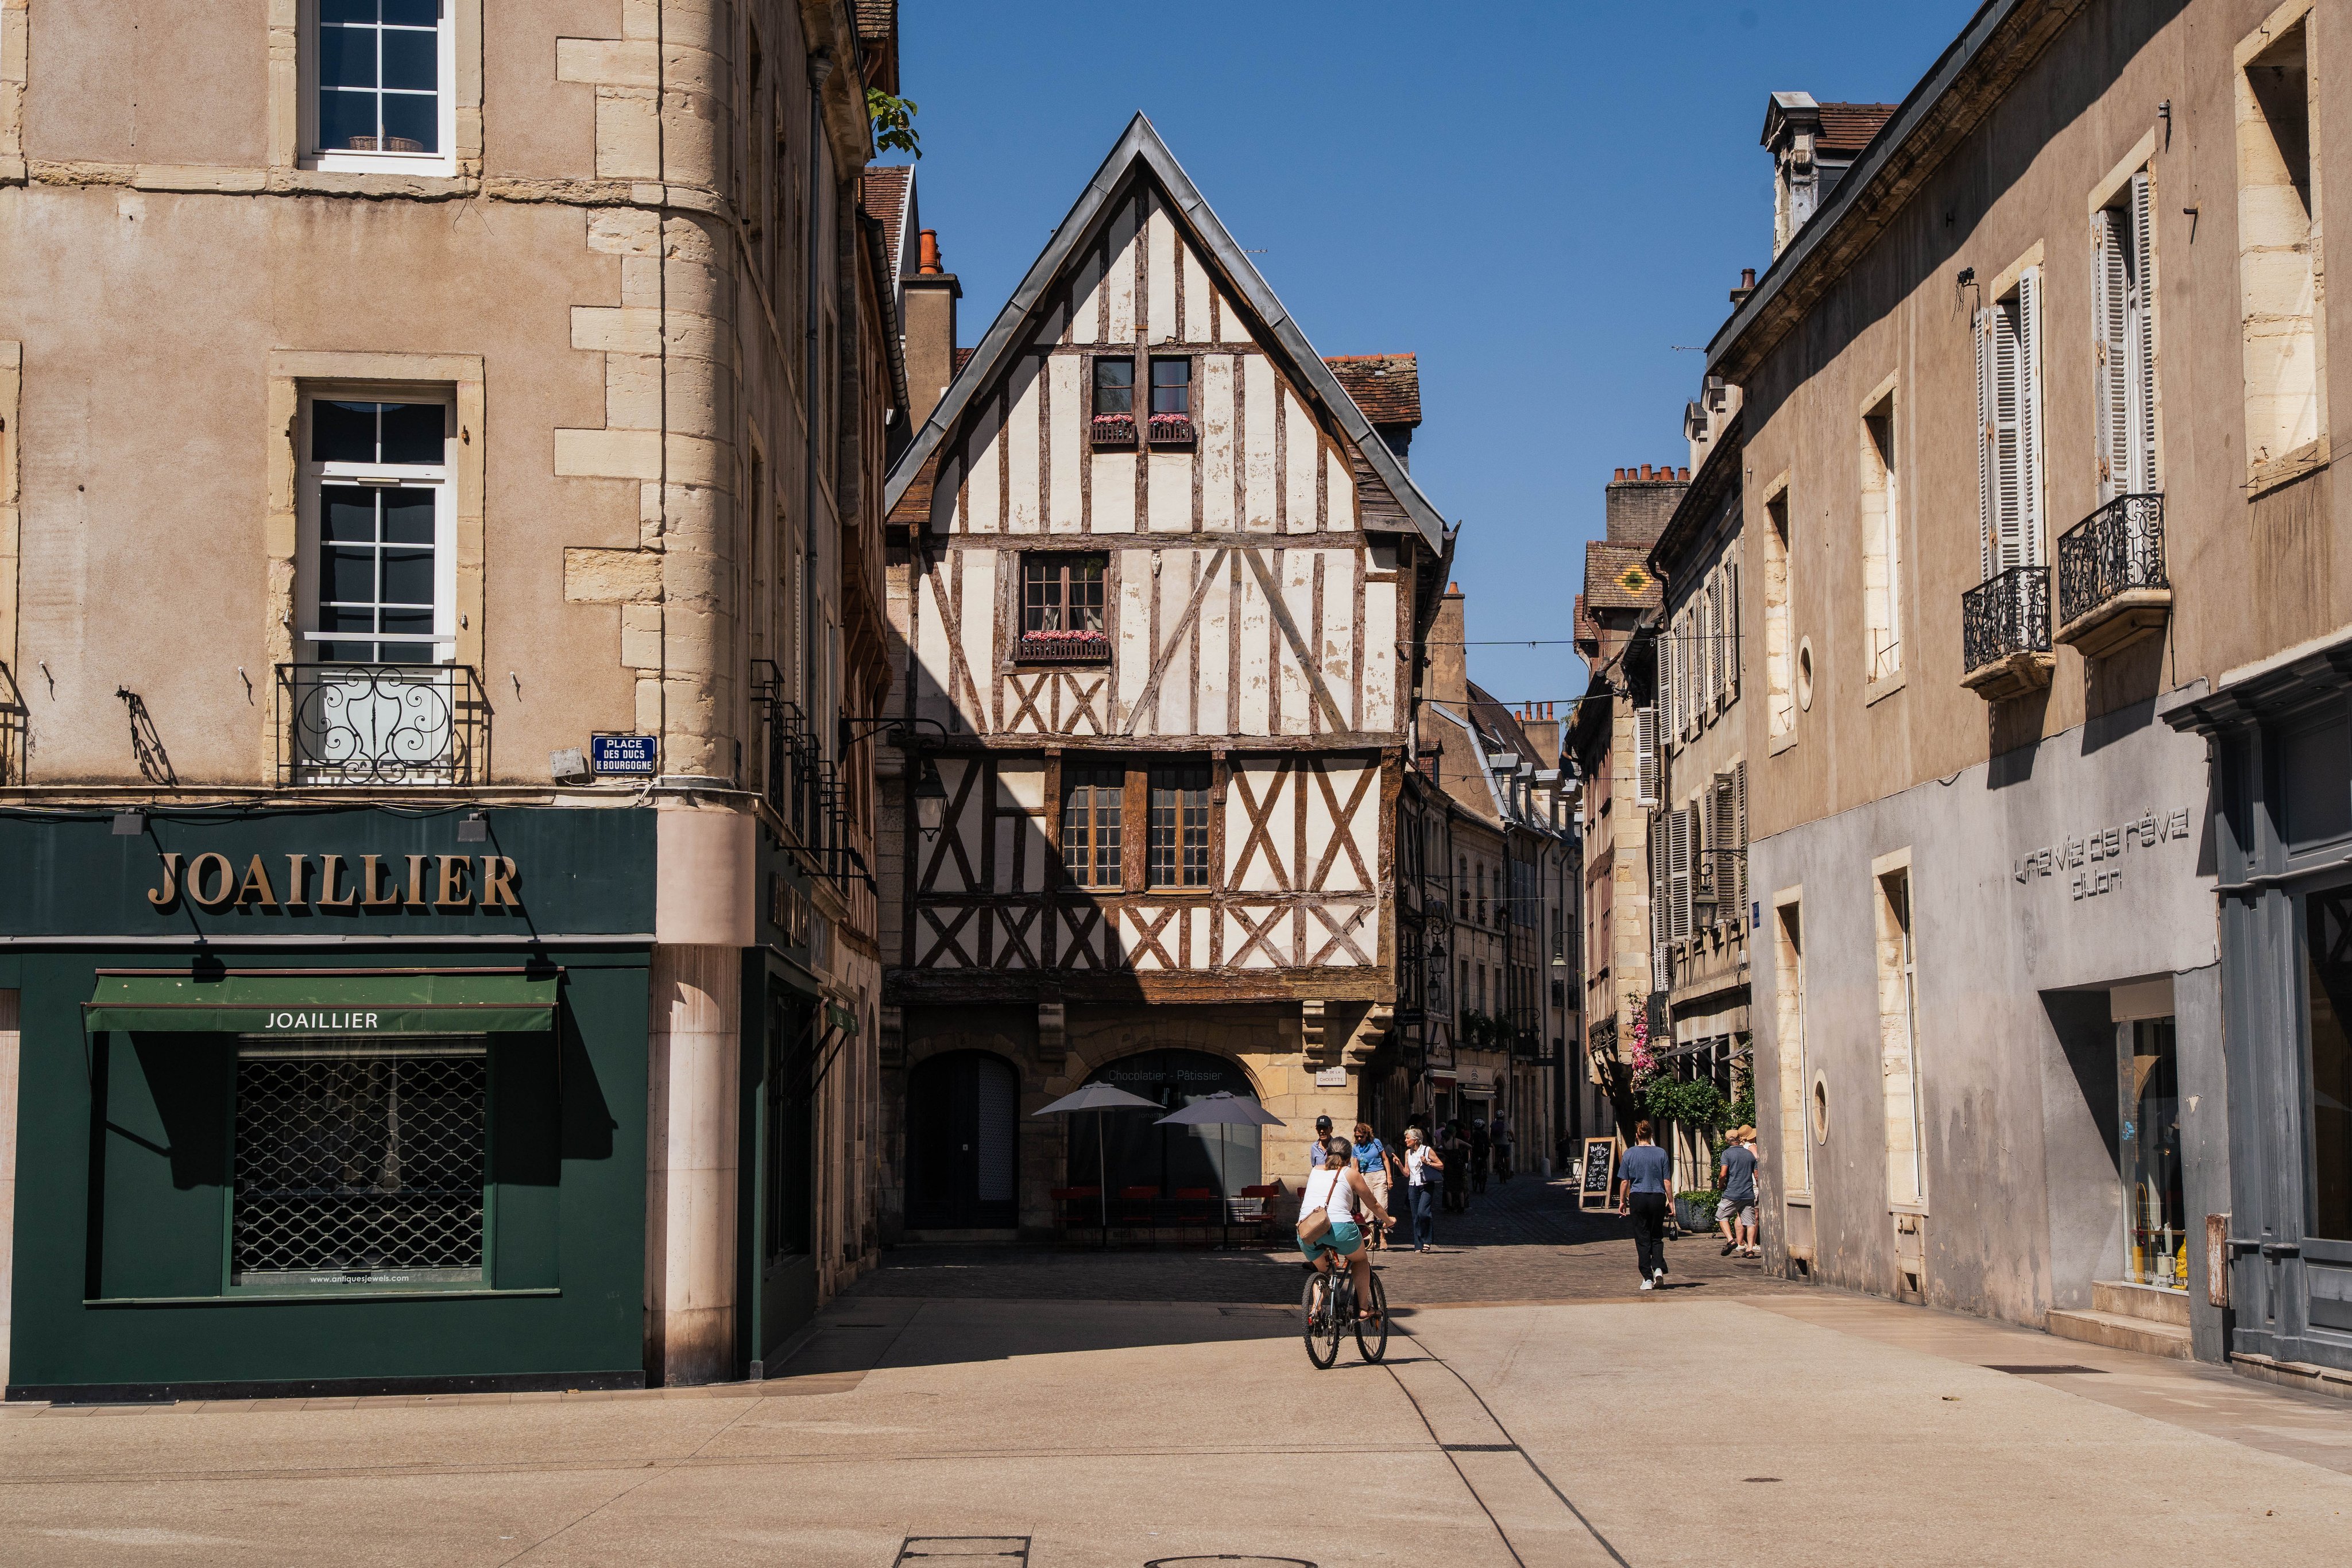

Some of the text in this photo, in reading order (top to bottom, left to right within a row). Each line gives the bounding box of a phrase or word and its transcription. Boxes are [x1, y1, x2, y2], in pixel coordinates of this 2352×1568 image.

[606, 740, 643, 748] PLACE
[604, 750, 645, 758] DES DUCS
[597, 760, 652, 769] DE BOURGOGNE
[2088, 820, 2119, 854] de
[148, 852, 520, 905] JOAILLIER
[265, 1013, 378, 1028] JOAILLIER
[1109, 1070, 1166, 1081] Chocolatier
[1177, 1070, 1222, 1081] Pâtissier
